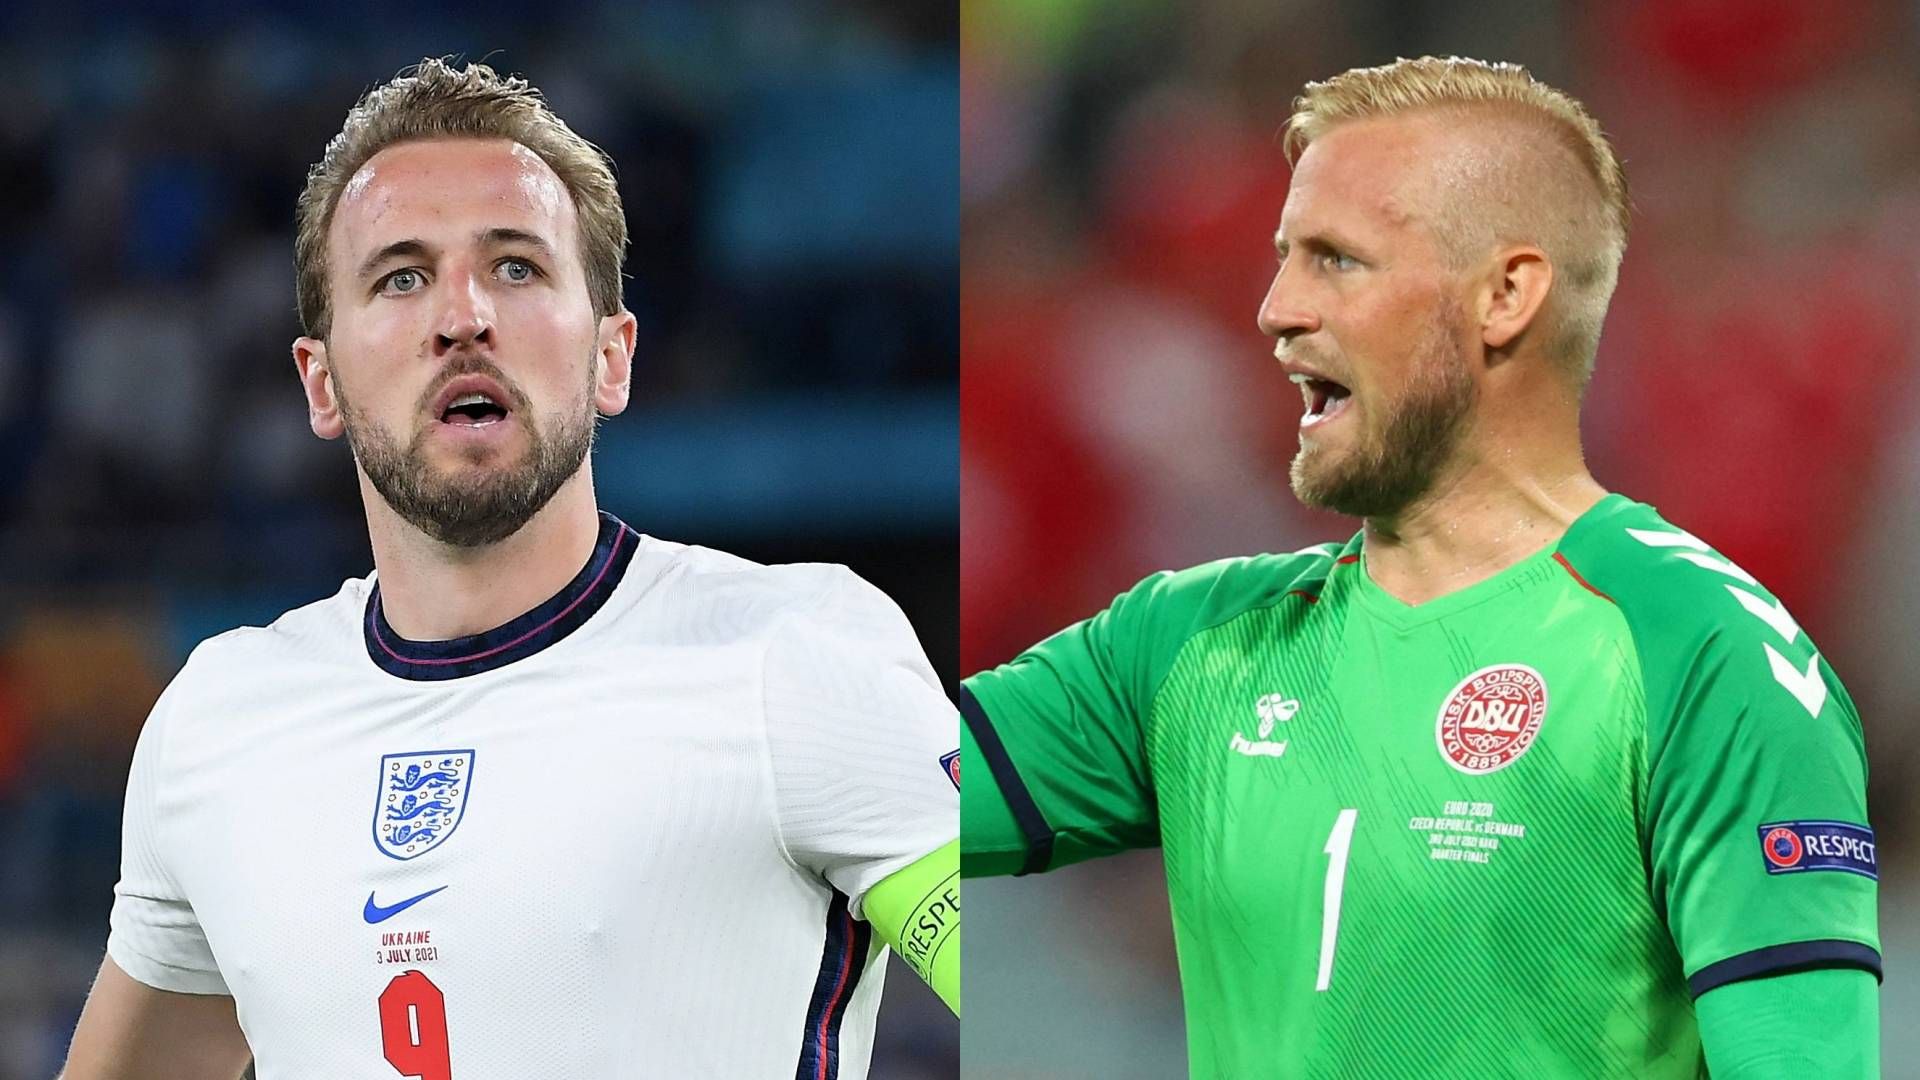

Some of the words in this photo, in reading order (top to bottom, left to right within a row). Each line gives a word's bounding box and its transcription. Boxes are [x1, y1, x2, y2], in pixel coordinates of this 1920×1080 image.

[1444, 690, 1471, 754] DANSK
[1460, 699, 1529, 733] DBU
[1507, 701, 1544, 757] UNION
[1459, 752, 1502, 769] 1889
[1443, 800, 1469, 816] EURO
[1469, 802, 1494, 817] 2020
[1409, 816, 1435, 830] CZECH
[1434, 817, 1474, 832] REPUBLIC
[1484, 821, 1526, 838] DENMARK
[1443, 834, 1461, 847] JULY
[1803, 834, 1876, 865] RESPECT
[1462, 850, 1490, 864] FINALS
[1314, 808, 1359, 992] 1
[382, 930, 431, 946] UKRAINE
[376, 950, 383, 964] 3
[386, 948, 411, 963] JULY
[415, 946, 438, 962] 2021
[378, 969, 452, 1080] 9
